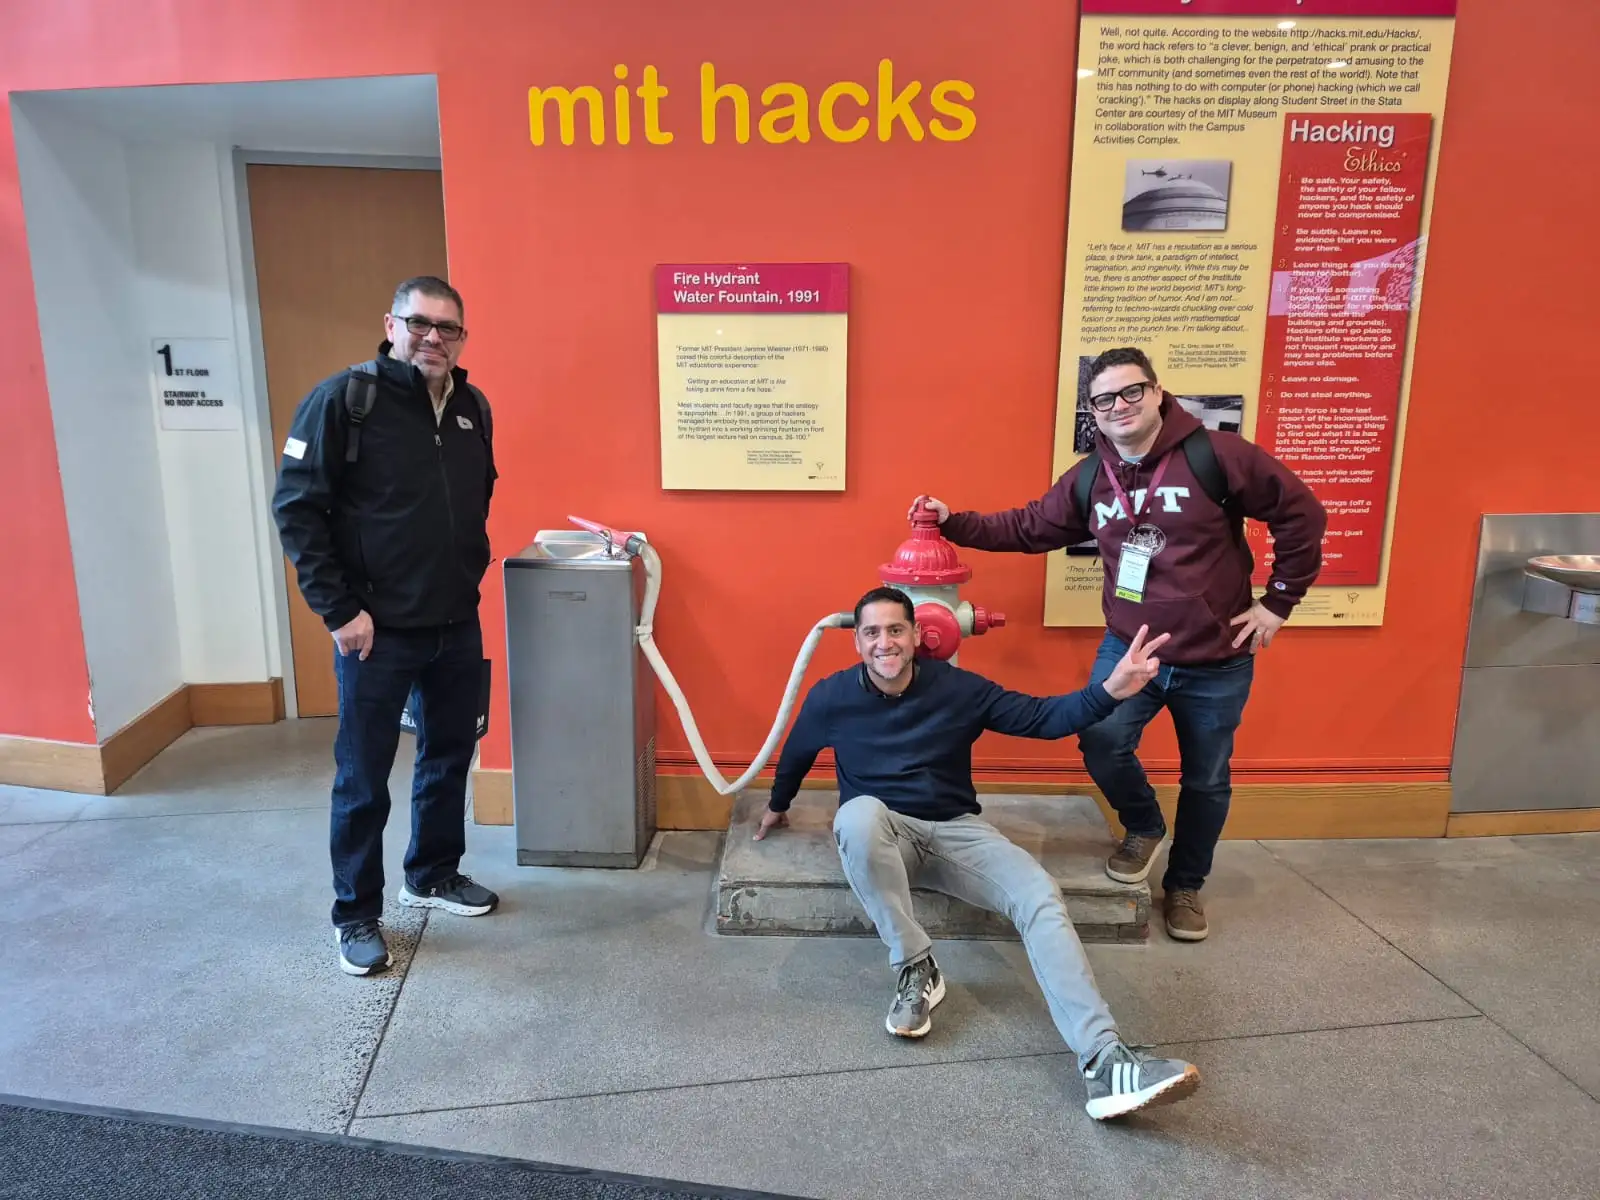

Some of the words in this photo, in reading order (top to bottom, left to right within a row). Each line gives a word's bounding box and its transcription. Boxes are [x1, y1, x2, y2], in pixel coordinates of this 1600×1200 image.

[1125, 27, 1140, 36] not
[1172, 28, 1219, 39] According
[1222, 28, 1232, 36] to
[1234, 28, 1249, 36] the
[1252, 28, 1289, 37] website
[1100, 41, 1114, 50] the
[1117, 41, 1140, 50] word
[1143, 41, 1165, 50] hack
[1168, 41, 1194, 50] refers
[1197, 41, 1206, 50] to
[1291, 42, 1309, 50] and
[1350, 42, 1376, 53] prank
[1391, 42, 1431, 54] practical
[1124, 54, 1150, 63] which
[1154, 54, 1161, 63] is
[1164, 54, 1185, 63] both
[1188, 55, 1240, 66] challenging
[1243, 55, 1256, 64] for
[1259, 55, 1273, 64] the
[1276, 55, 1334, 66] perpetrators
[1355, 56, 1395, 67] amusing
[1397, 56, 1407, 64] to
[1408, 56, 1424, 65] the
[1098, 68, 1116, 77] MIT
[1118, 68, 1169, 79] community
[1195, 68, 1246, 77] sometimes
[1273, 69, 1288, 78] the
[1290, 69, 1308, 78] rest
[1310, 69, 1320, 78] of
[1322, 69, 1336, 78] the
[1376, 70, 1398, 78] Note
[1400, 70, 1419, 78] that
[1097, 81, 1113, 90] this
[1116, 81, 1132, 90] has
[1135, 82, 1170, 93] nothing
[1173, 82, 1183, 90] to
[1184, 82, 1197, 90] do
[1200, 82, 1219, 91] with
[1221, 82, 1267, 93] computer
[1317, 82, 1353, 94] hacking
[1404, 83, 1420, 92] call
[528, 64, 674, 146] mit
[700, 58, 976, 144] hacks
[1153, 95, 1171, 103] The
[1174, 95, 1201, 104] hacks
[1218, 95, 1251, 106] display
[1253, 95, 1279, 106] along
[1281, 95, 1318, 104] Student
[1320, 96, 1347, 104] Street
[1350, 96, 1358, 104] in
[1361, 96, 1377, 104] the
[1378, 96, 1402, 104] Stata
[1096, 108, 1126, 117] Center
[1145, 109, 1186, 120] courtesy
[1188, 109, 1198, 118] of
[1200, 109, 1215, 118] the
[1217, 109, 1236, 118] MIT
[1238, 109, 1277, 118] Museum
[1094, 122, 1102, 130] in
[1105, 122, 1164, 130] collaboration
[1168, 122, 1187, 130] with
[1189, 122, 1204, 131] the
[1206, 122, 1245, 133] Campus
[1290, 119, 1395, 147] Hacking
[1093, 135, 1135, 144] Activities
[674, 272, 700, 285] Fire
[704, 272, 760, 288] Hydrant
[674, 291, 714, 303] Water
[719, 290, 783, 304] Fountain,
[787, 290, 820, 303] 1991
[1322, 375, 1360, 383] damage.
[1333, 391, 1372, 399] anything.
